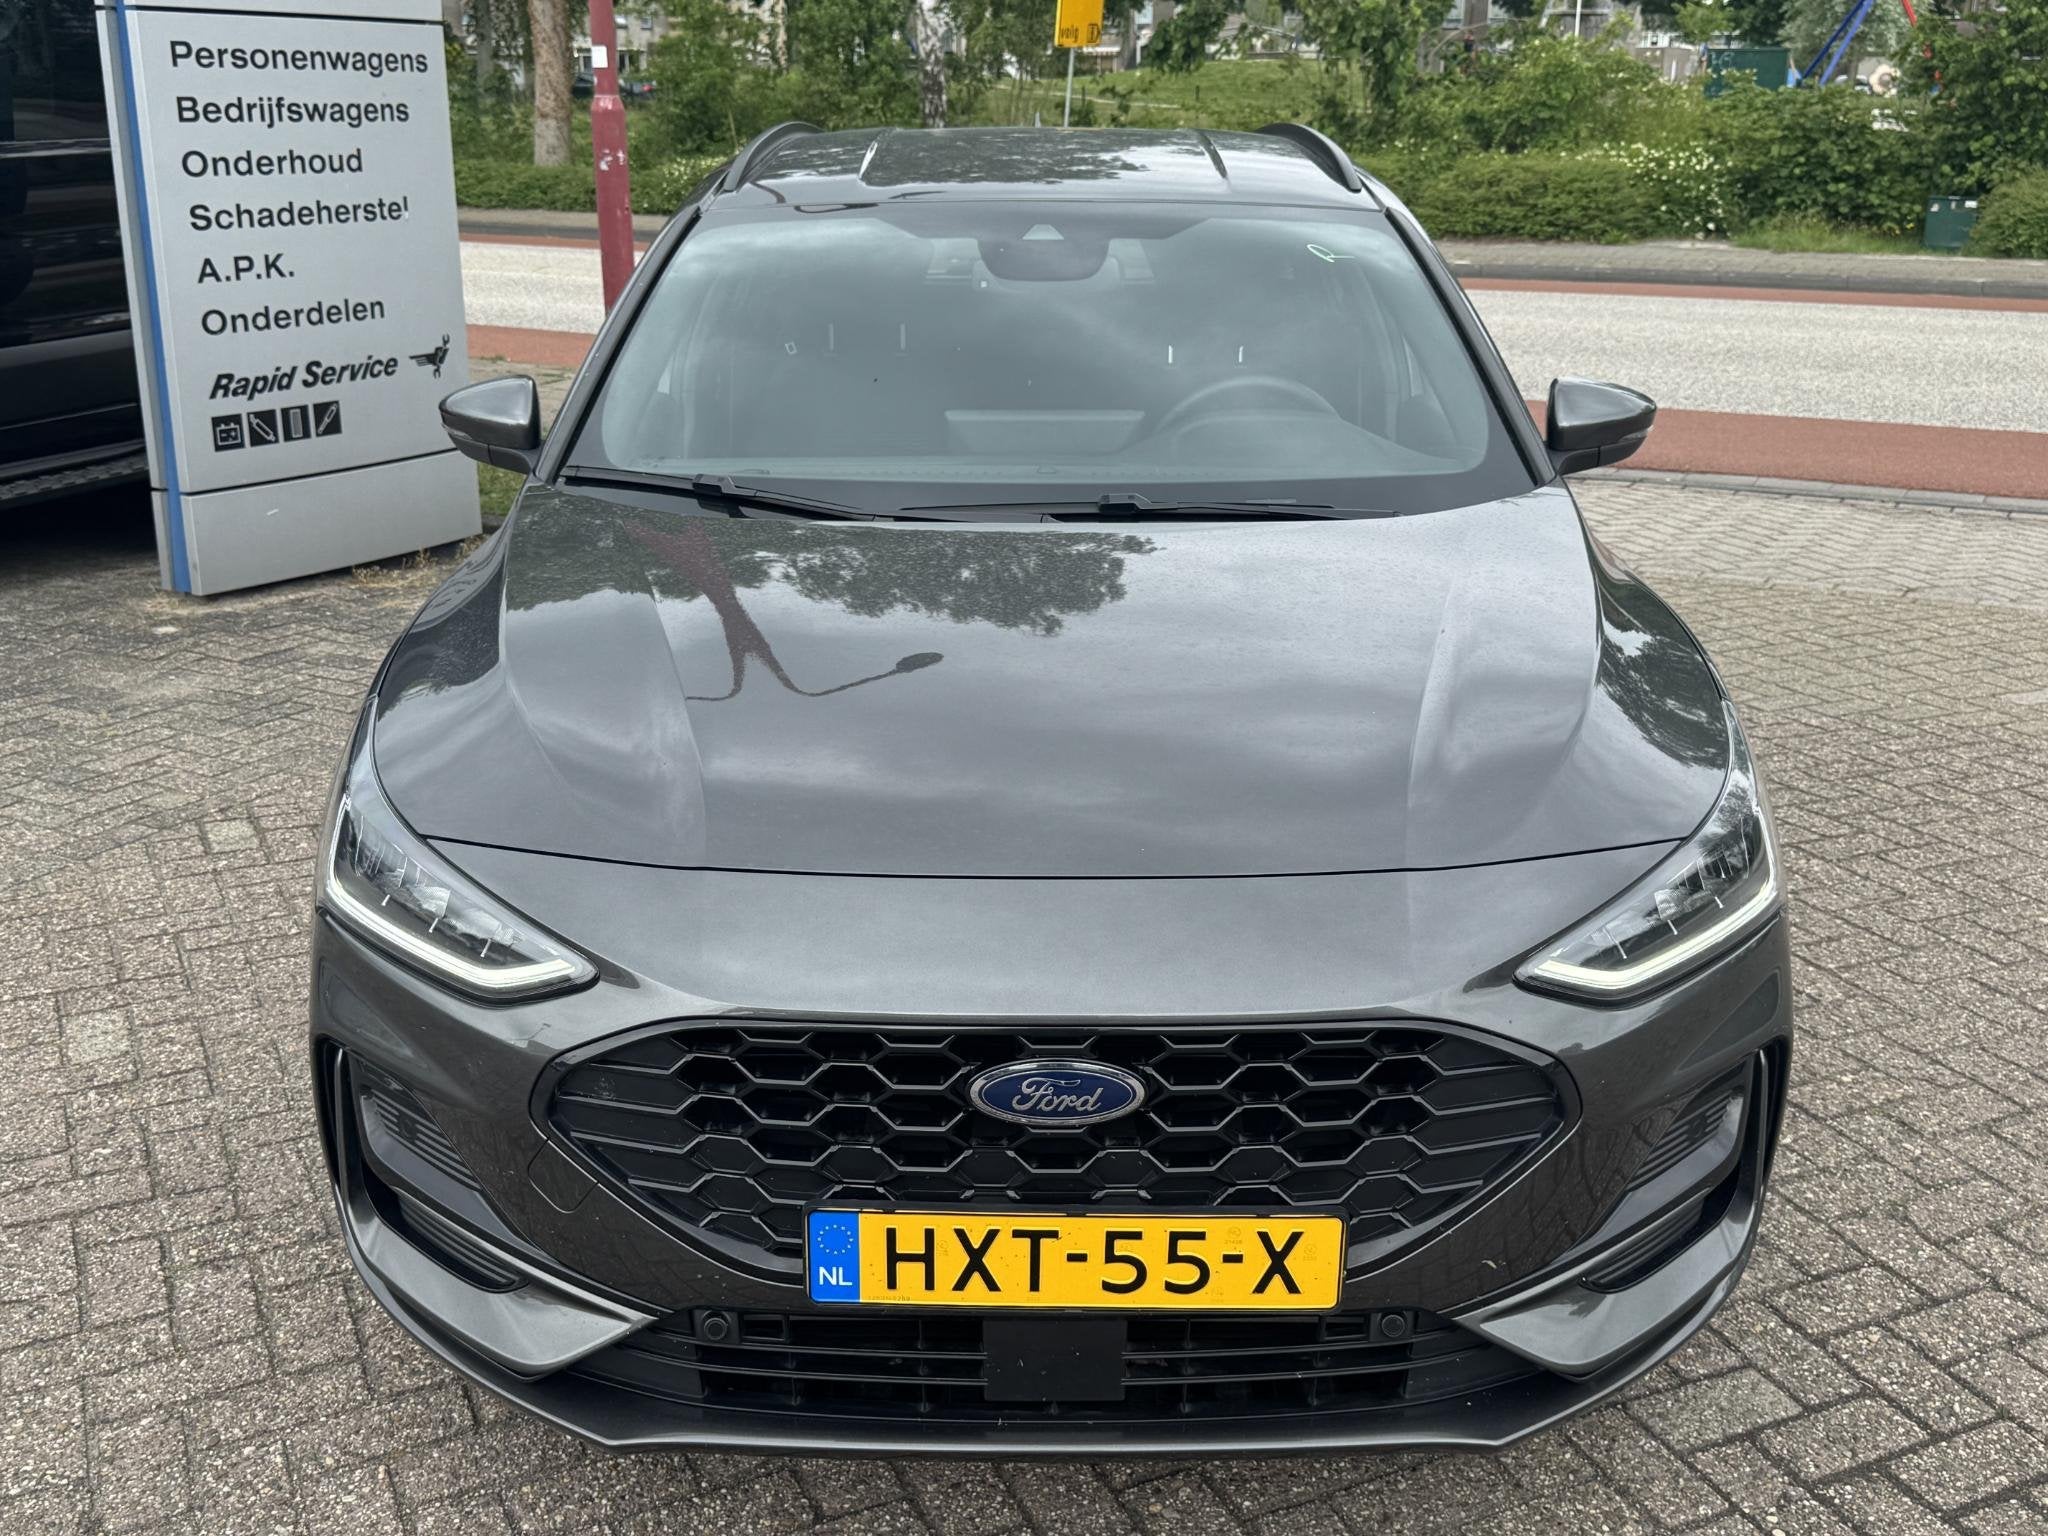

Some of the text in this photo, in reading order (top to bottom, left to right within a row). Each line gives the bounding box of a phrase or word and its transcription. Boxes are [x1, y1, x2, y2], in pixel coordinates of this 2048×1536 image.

[169, 40, 429, 78] Personenwagens
[175, 95, 410, 129] Bedrijfswagens
[181, 148, 364, 178] Onderhoud
[188, 195, 409, 232] Schadeherstel
[197, 252, 296, 284] A.P.K.
[201, 298, 386, 336] Onderdelen
[208, 354, 399, 401] Rapid Service
[1011, 1077, 1104, 1112] Ford
[818, 1266, 853, 1287] NL
[884, 1226, 1305, 1295] HXT-55-X
